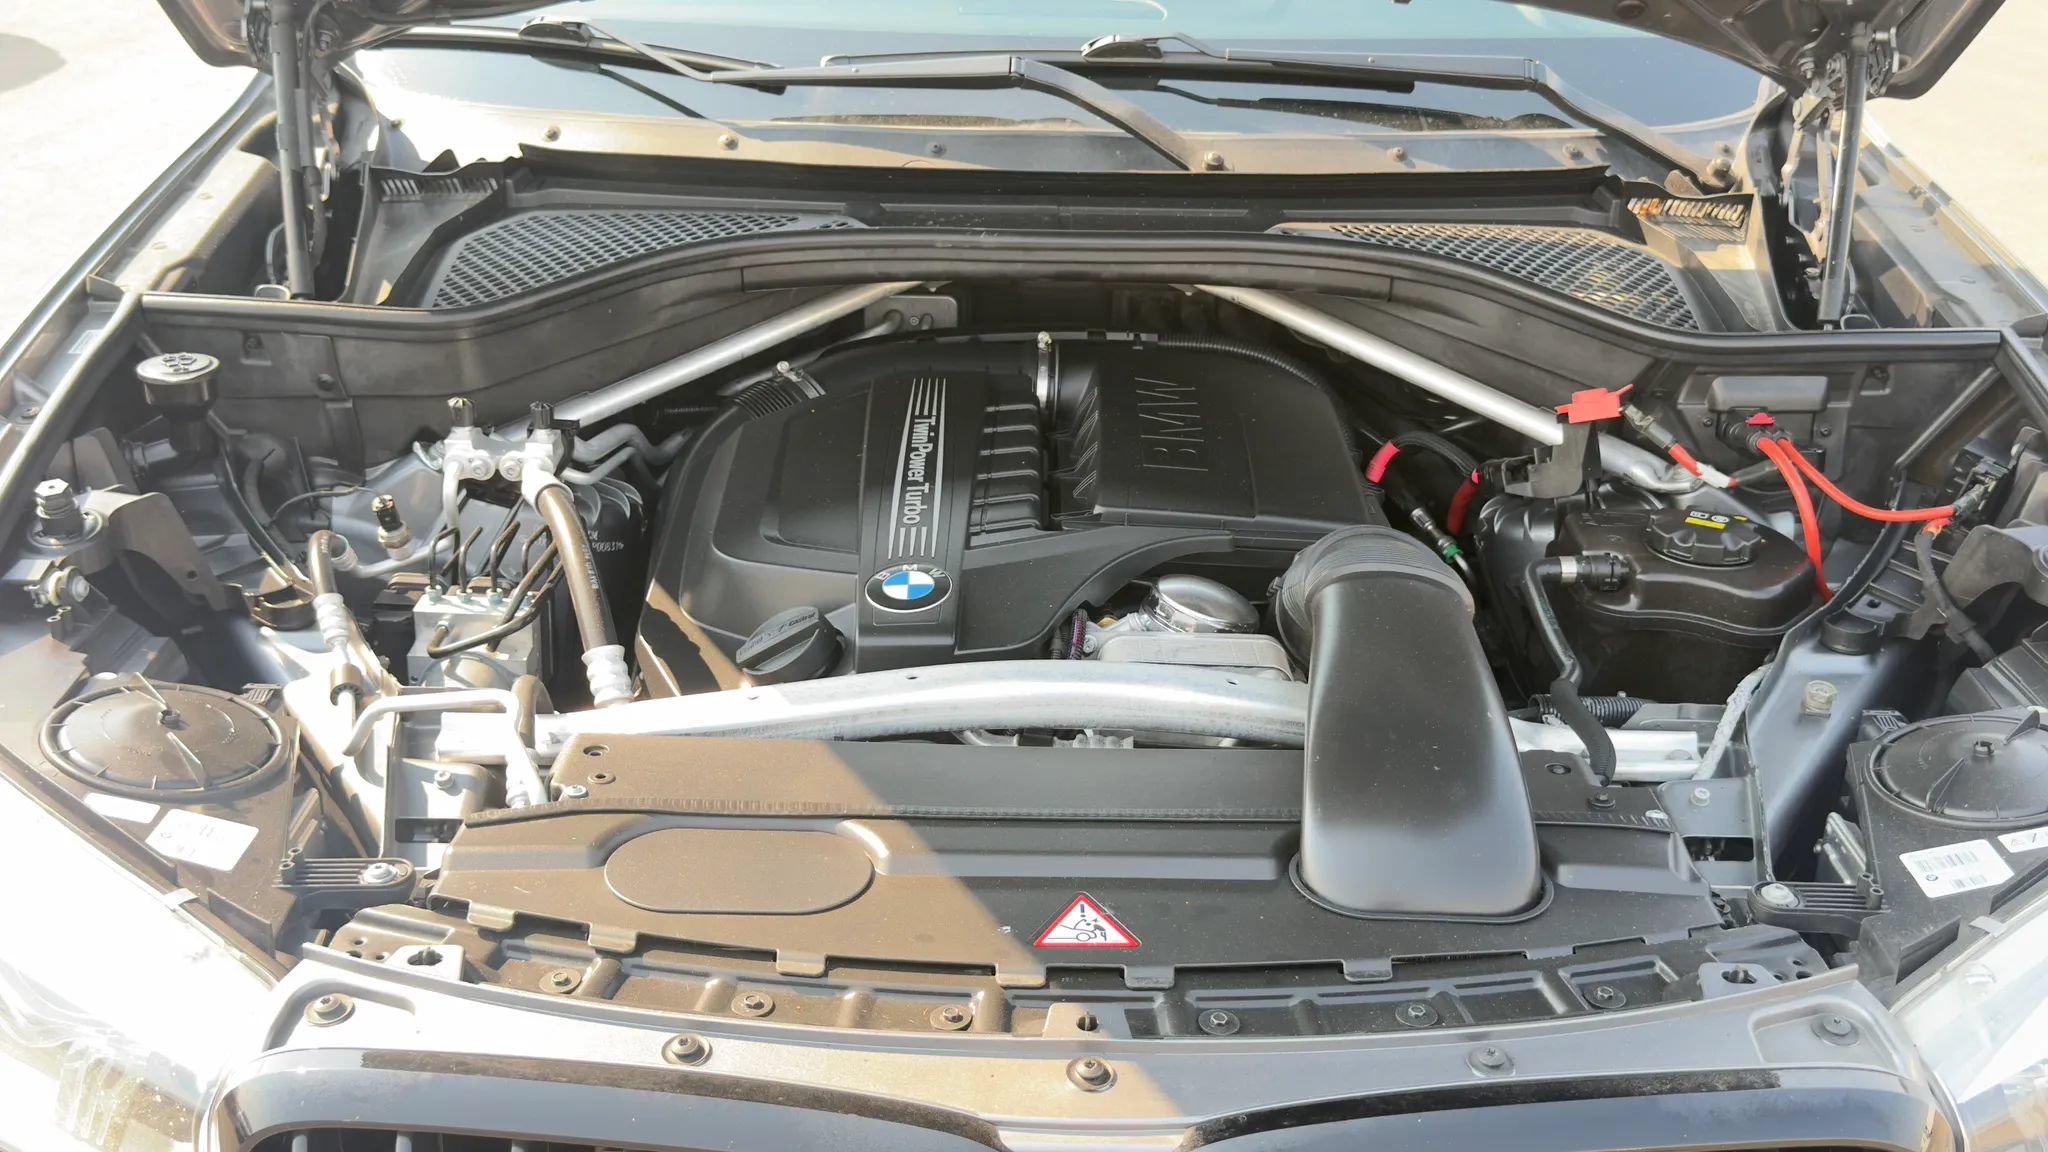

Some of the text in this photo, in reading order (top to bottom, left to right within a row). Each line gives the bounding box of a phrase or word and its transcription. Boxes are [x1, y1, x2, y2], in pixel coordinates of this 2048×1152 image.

[902, 415, 936, 525] TwinPower Turbo
[1134, 377, 1209, 471] BMW
[874, 564, 946, 580] BMW
